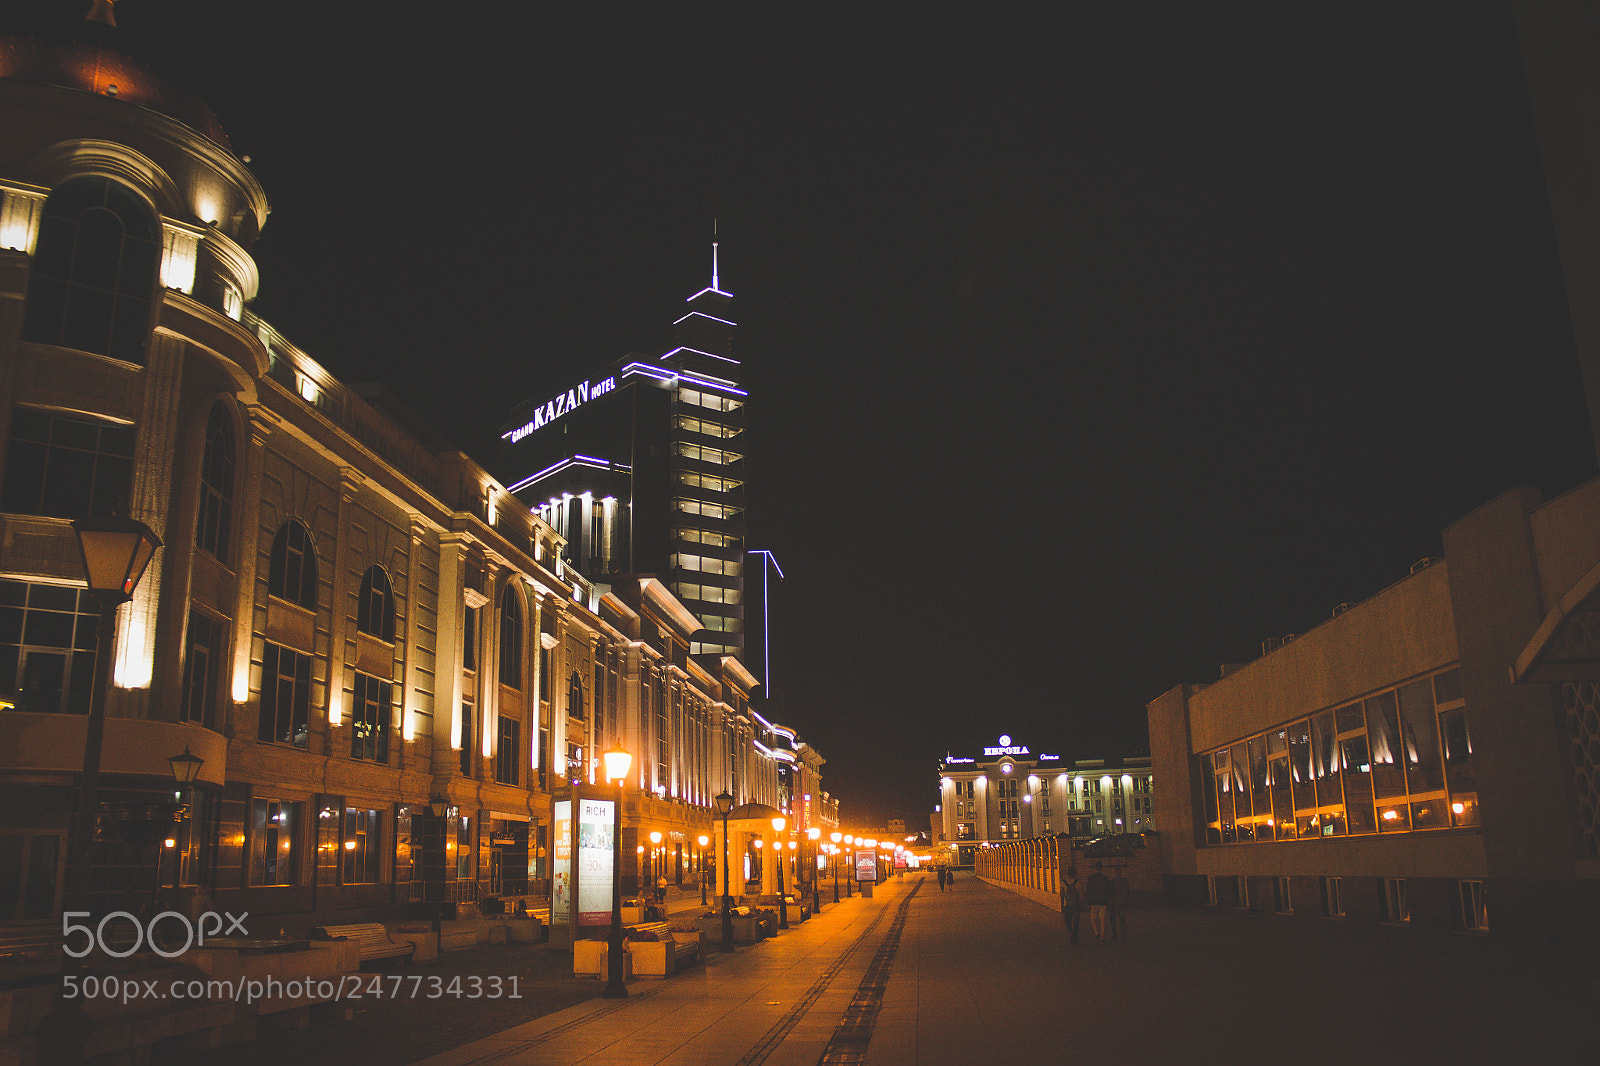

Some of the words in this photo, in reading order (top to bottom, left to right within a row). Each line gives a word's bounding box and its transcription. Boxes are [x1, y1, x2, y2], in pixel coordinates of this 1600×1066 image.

[512, 421, 534, 443] GRAND
[534, 381, 589, 430] KAZAN
[591, 377, 616, 399] HOTEL
[586, 806, 606, 817] RICH
